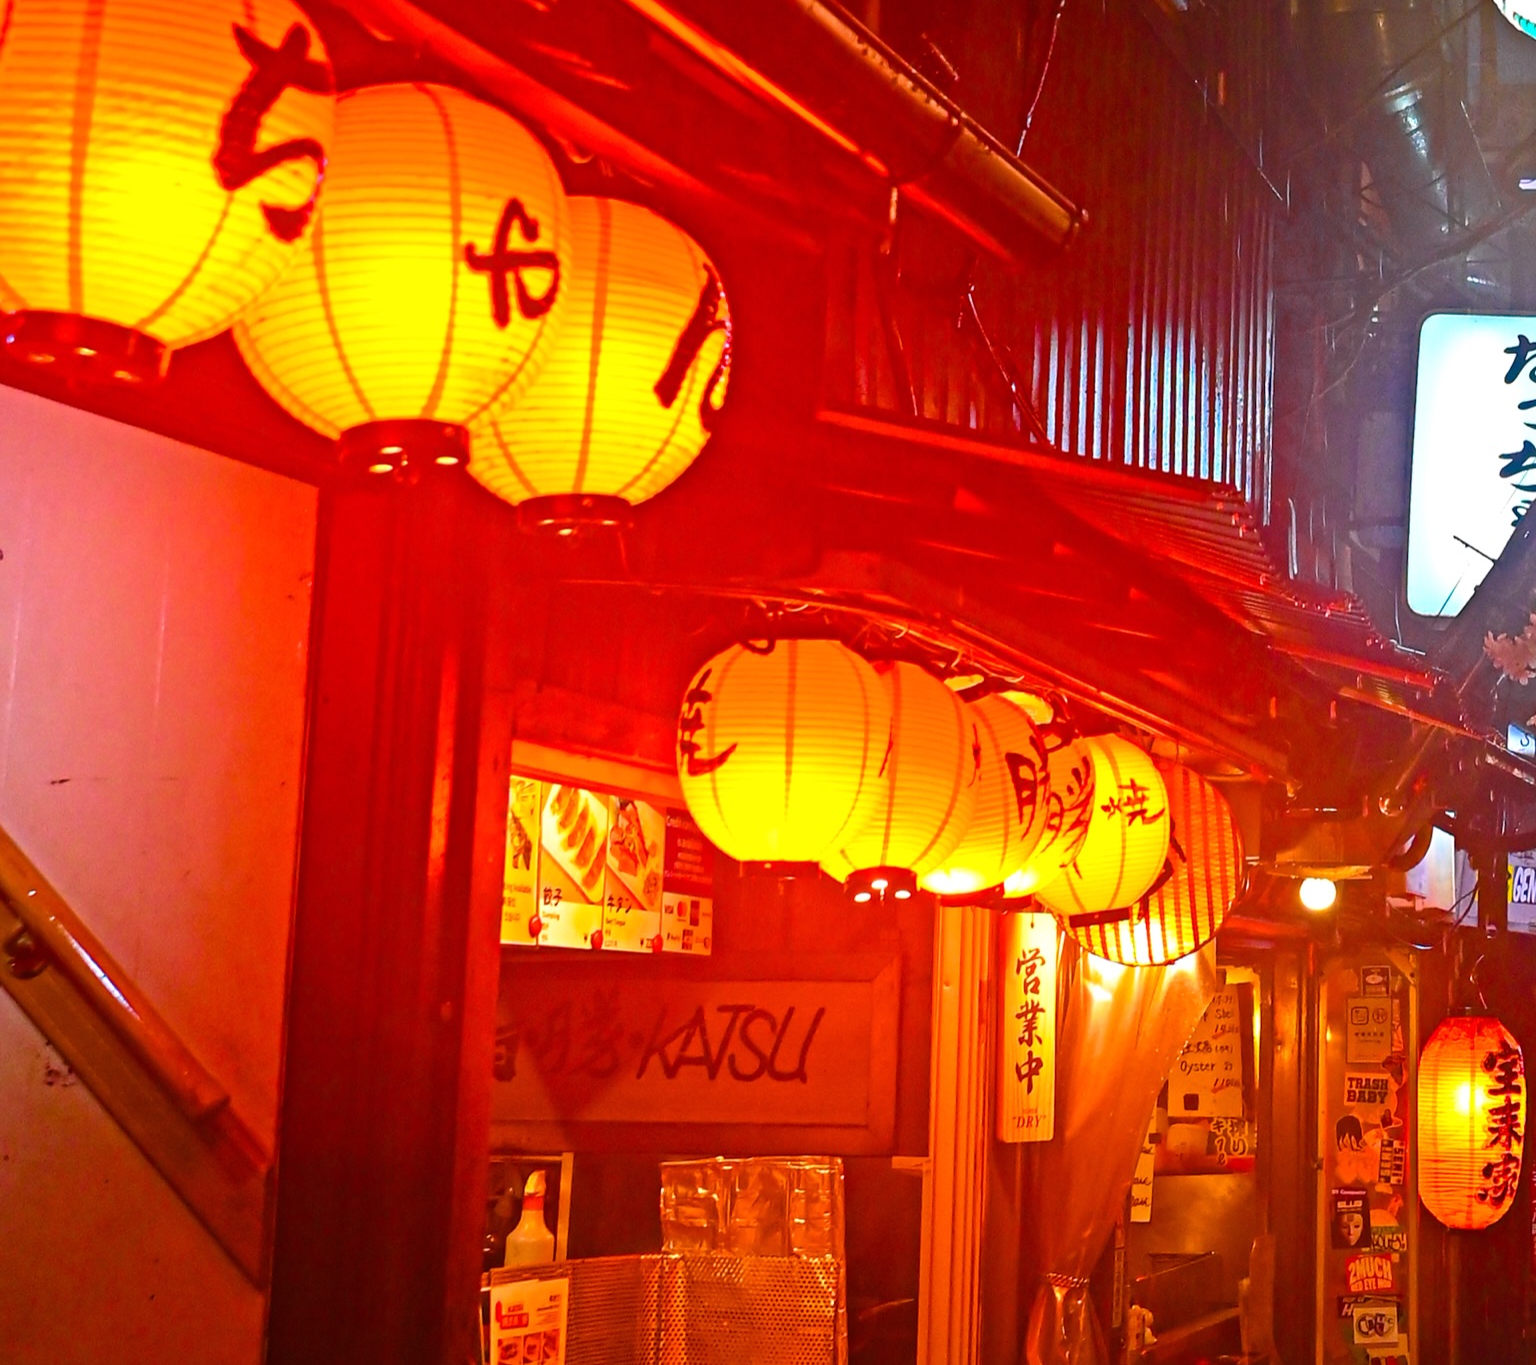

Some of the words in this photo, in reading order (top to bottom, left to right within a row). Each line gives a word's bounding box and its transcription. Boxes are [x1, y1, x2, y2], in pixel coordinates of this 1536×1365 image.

[1100, 779, 1165, 826] 焼
[1015, 947, 1046, 1096] 営業中
[636, 1005, 826, 1084] KATSU
[1180, 1060, 1215, 1076] Oyster
[1346, 1090, 1388, 1104] BABY
[1347, 1077, 1388, 1090] TRASH
[1348, 1256, 1392, 1285] 2MUCH
